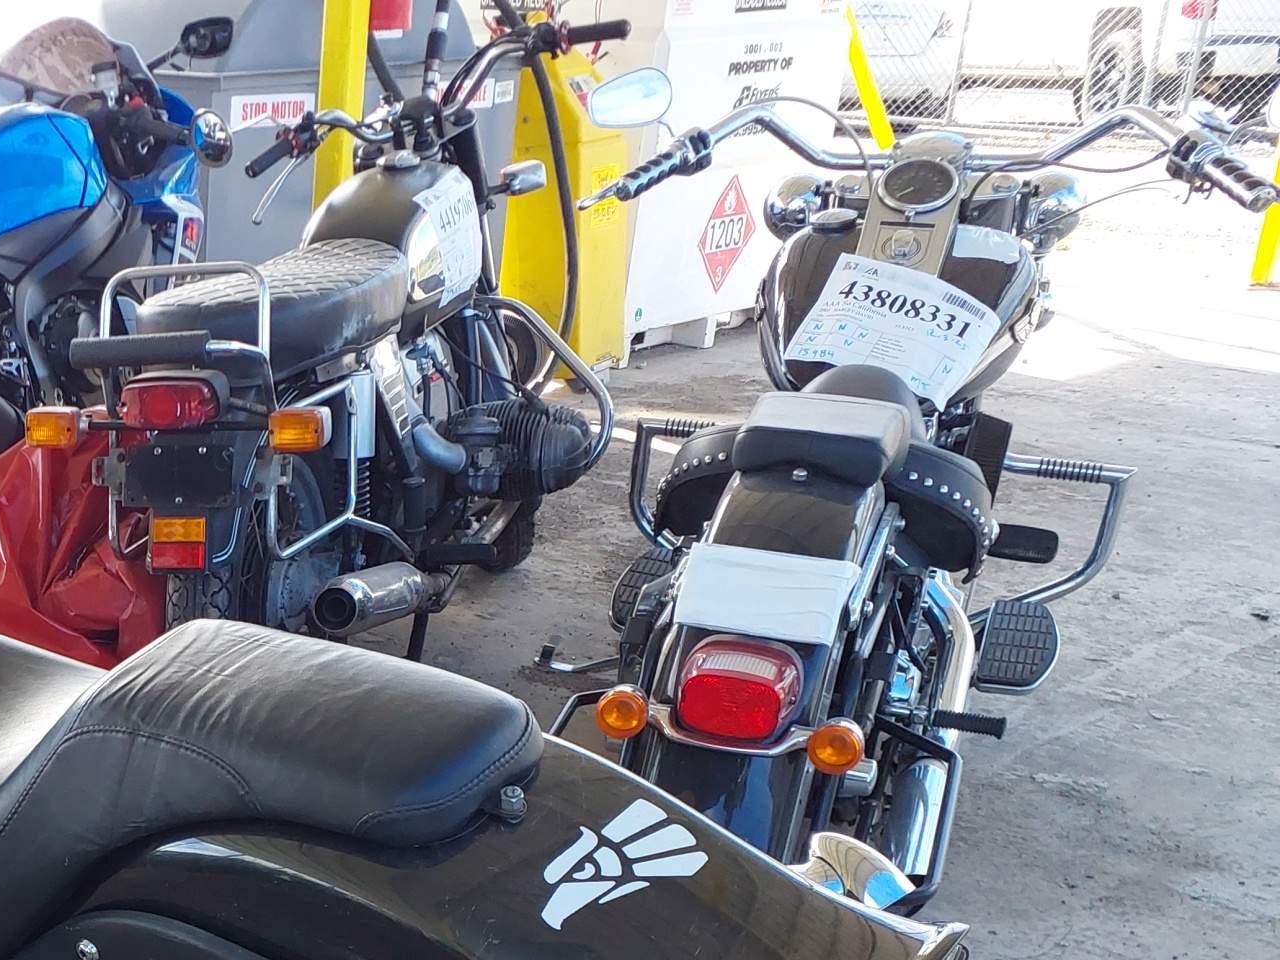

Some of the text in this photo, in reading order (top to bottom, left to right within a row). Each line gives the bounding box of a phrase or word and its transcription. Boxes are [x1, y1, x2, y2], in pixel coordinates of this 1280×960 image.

[728, 57, 793, 76] PROPERTY OF
[242, 101, 305, 121] STOP MOTOR
[710, 217, 744, 250] 1203
[839, 280, 972, 339] 43808331
[852, 301, 888, 319] California
